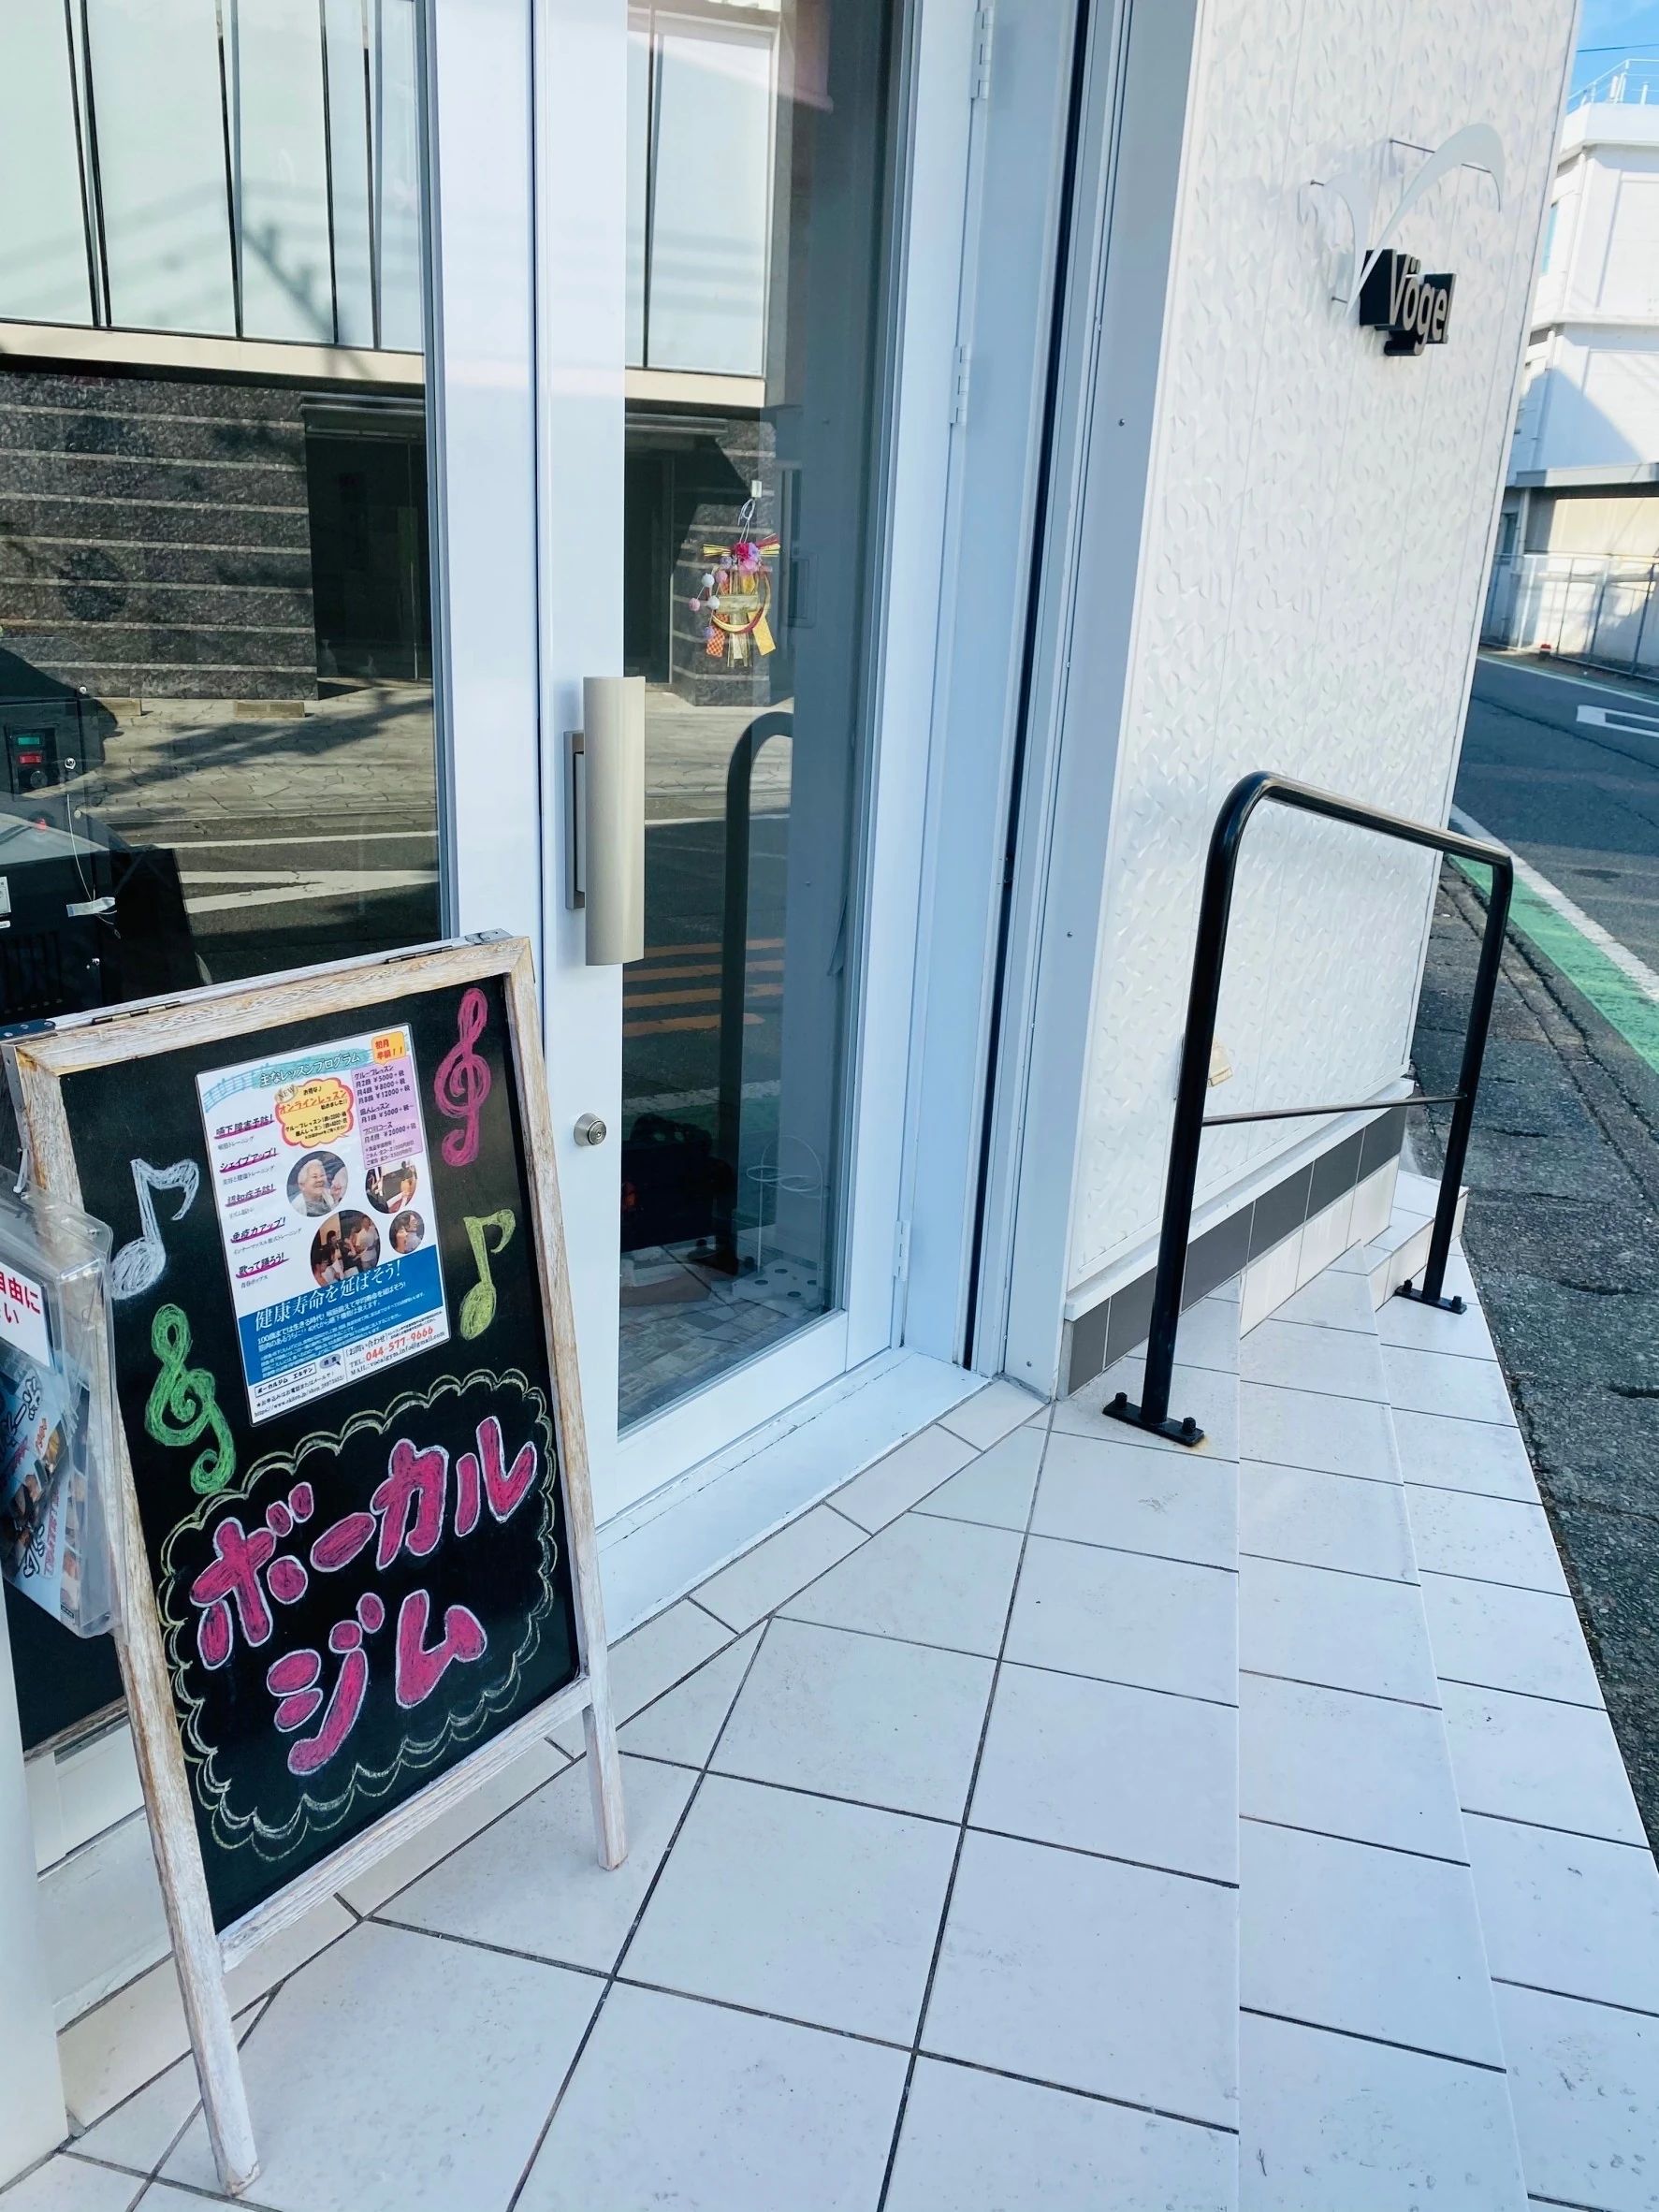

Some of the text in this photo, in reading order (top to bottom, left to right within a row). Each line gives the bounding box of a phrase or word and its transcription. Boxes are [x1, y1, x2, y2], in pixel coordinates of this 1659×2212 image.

[1387, 249, 1457, 356] Vögel
[261, 1053, 360, 1087] 主なレッスンプログラム
[375, 1038, 389, 1049] 初月
[278, 1089, 346, 1113] オンラインレッスン
[253, 1259, 401, 1329] 健康寿命を延ばそう！
[365, 1325, 433, 1361] 044-577-9666
[190, 1416, 537, 1670] ボーカル
[267, 1589, 488, 1775] ジム
